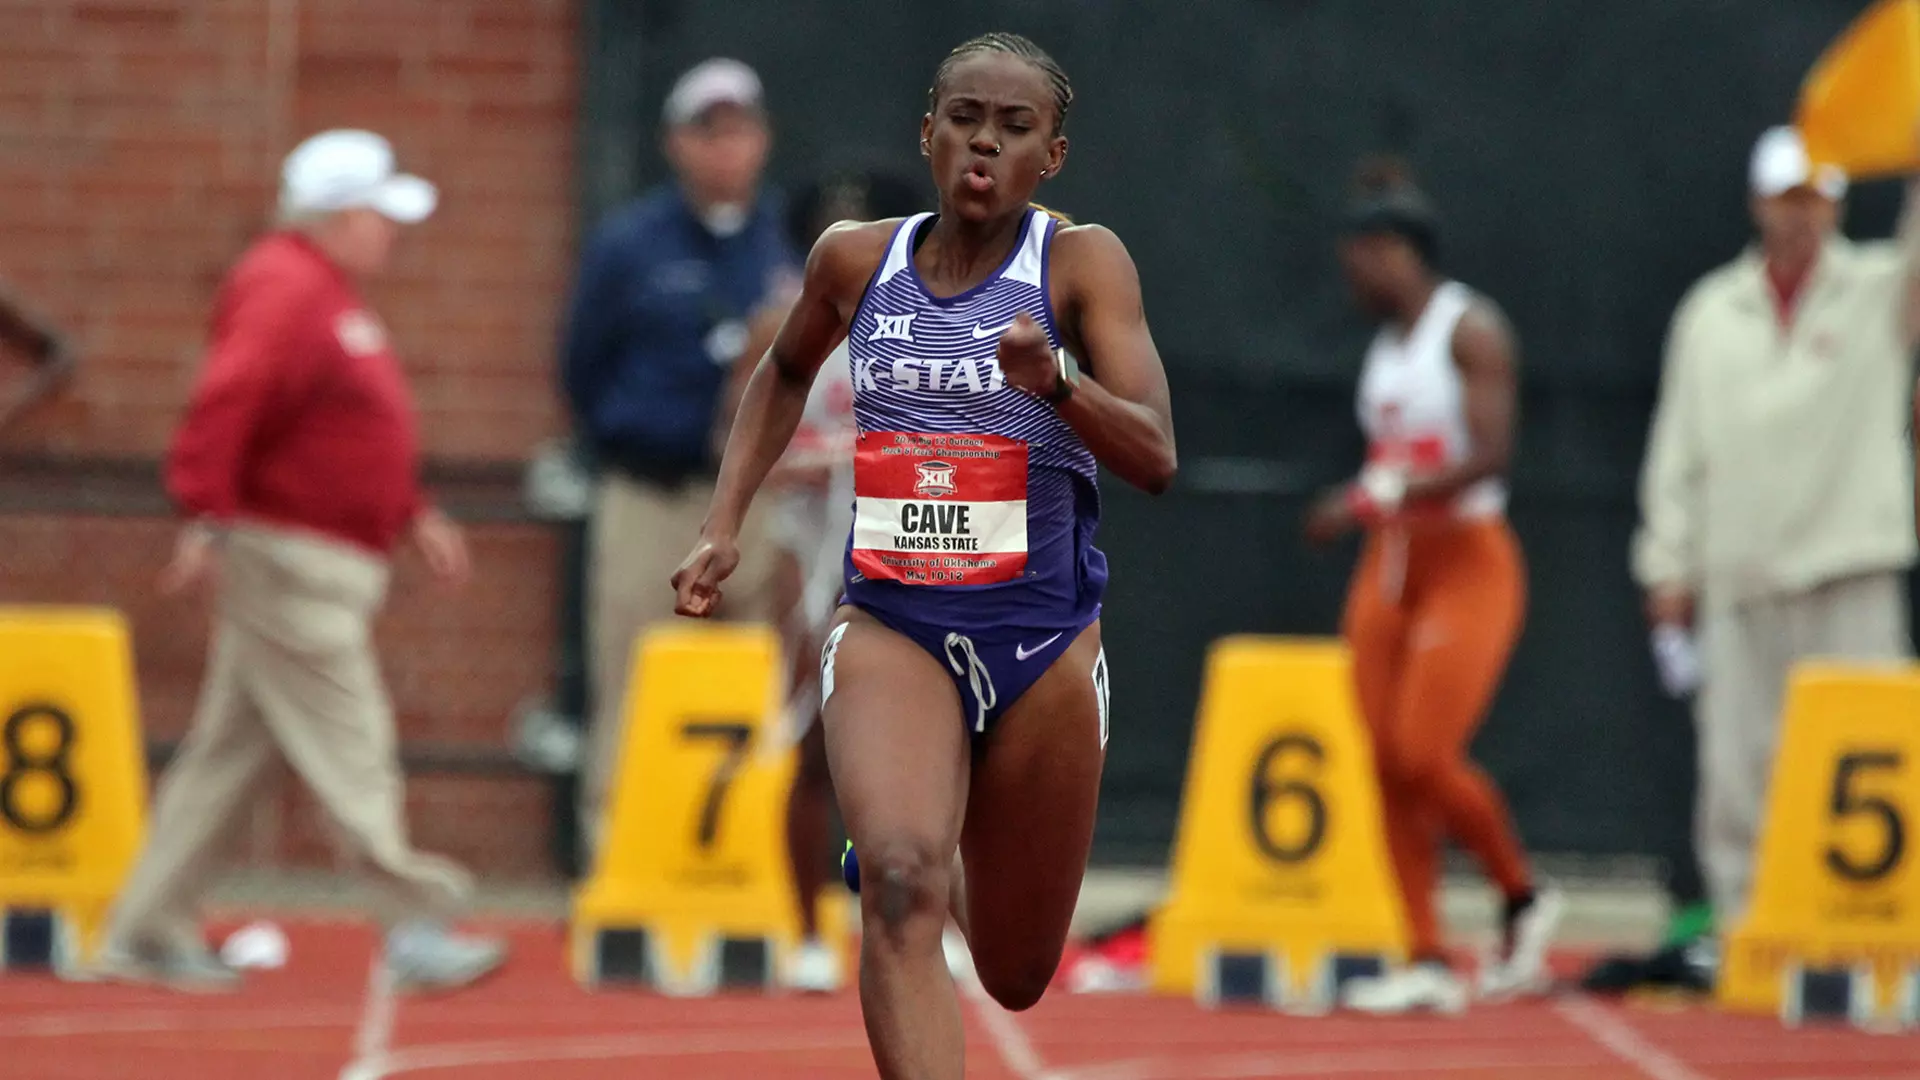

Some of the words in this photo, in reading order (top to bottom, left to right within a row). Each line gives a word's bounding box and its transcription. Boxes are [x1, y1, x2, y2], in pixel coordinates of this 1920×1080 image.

[855, 358, 1004, 392] K-STAT
[882, 446, 901, 455] Track
[912, 447, 934, 456] Field
[936, 448, 1000, 459] Championship
[935, 437, 946, 446] 12
[949, 437, 984, 447] Outdoor
[902, 503, 970, 534] CAVE
[894, 535, 940, 550] KANSAS
[943, 536, 978, 551] STATE
[881, 555, 926, 568] University
[929, 558, 940, 568] of
[943, 558, 996, 568] Oklahoma
[906, 571, 926, 581] May
[931, 571, 963, 581] 10-12
[0, 703, 76, 833] 8
[680, 721, 753, 849] 7
[1251, 733, 1326, 864] 6
[1827, 753, 1905, 882] 5
